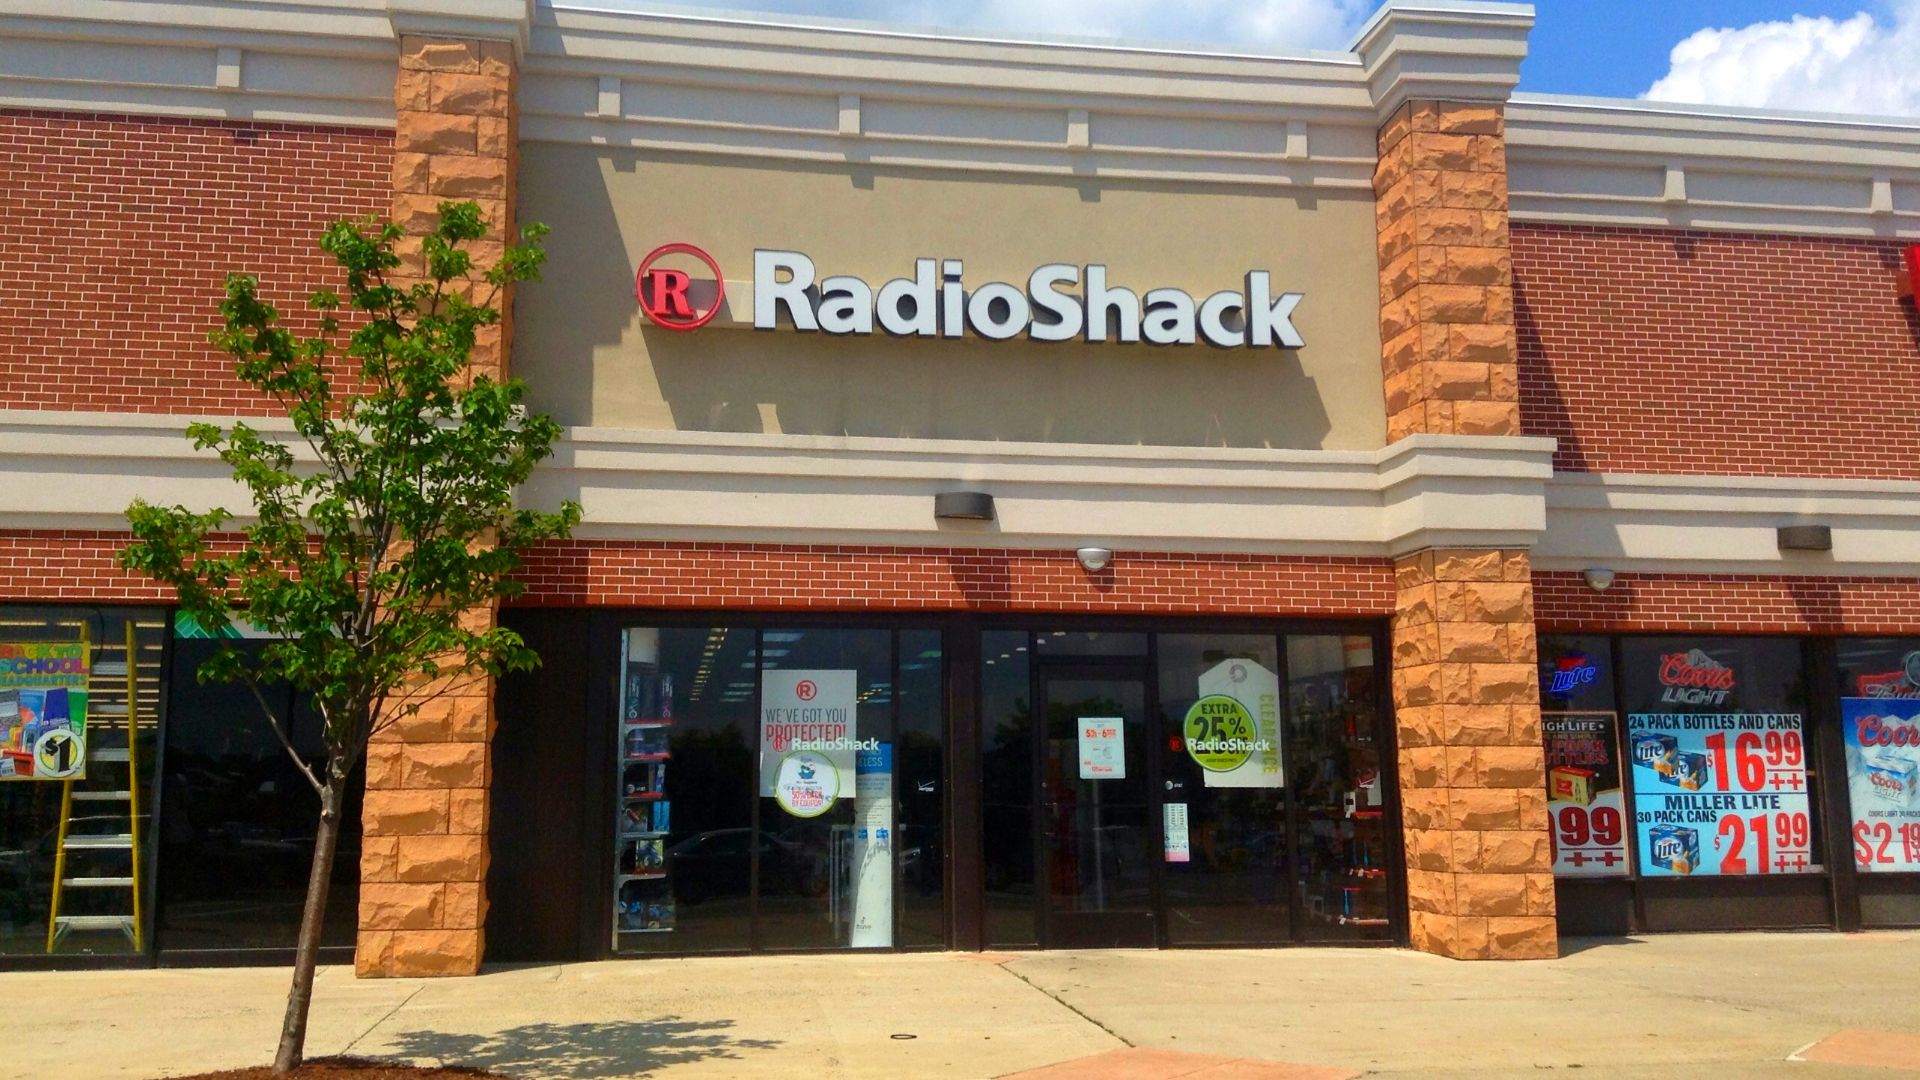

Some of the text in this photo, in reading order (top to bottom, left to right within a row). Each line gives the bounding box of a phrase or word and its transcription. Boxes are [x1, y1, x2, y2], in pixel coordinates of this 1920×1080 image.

[753, 248, 1306, 348] RadioShack
[0, 658, 89, 674] SCHOOL
[1659, 652, 1736, 689] Coors
[765, 708, 847, 723] WE'VE GOT YOU
[1201, 703, 1238, 715] EXTRA
[1542, 721, 1597, 731] IGH LIFE
[1630, 714, 1801, 730] 24 PACK BOTTLES AND CANS
[766, 724, 847, 742] PROTECTED!
[1855, 714, 1920, 748] Coor
[791, 737, 880, 751] RadioShack
[1187, 738, 1270, 751] RadioShack
[1664, 795, 1781, 810] MILLER LITE
[1637, 810, 1718, 823] 30 PACK CANS
